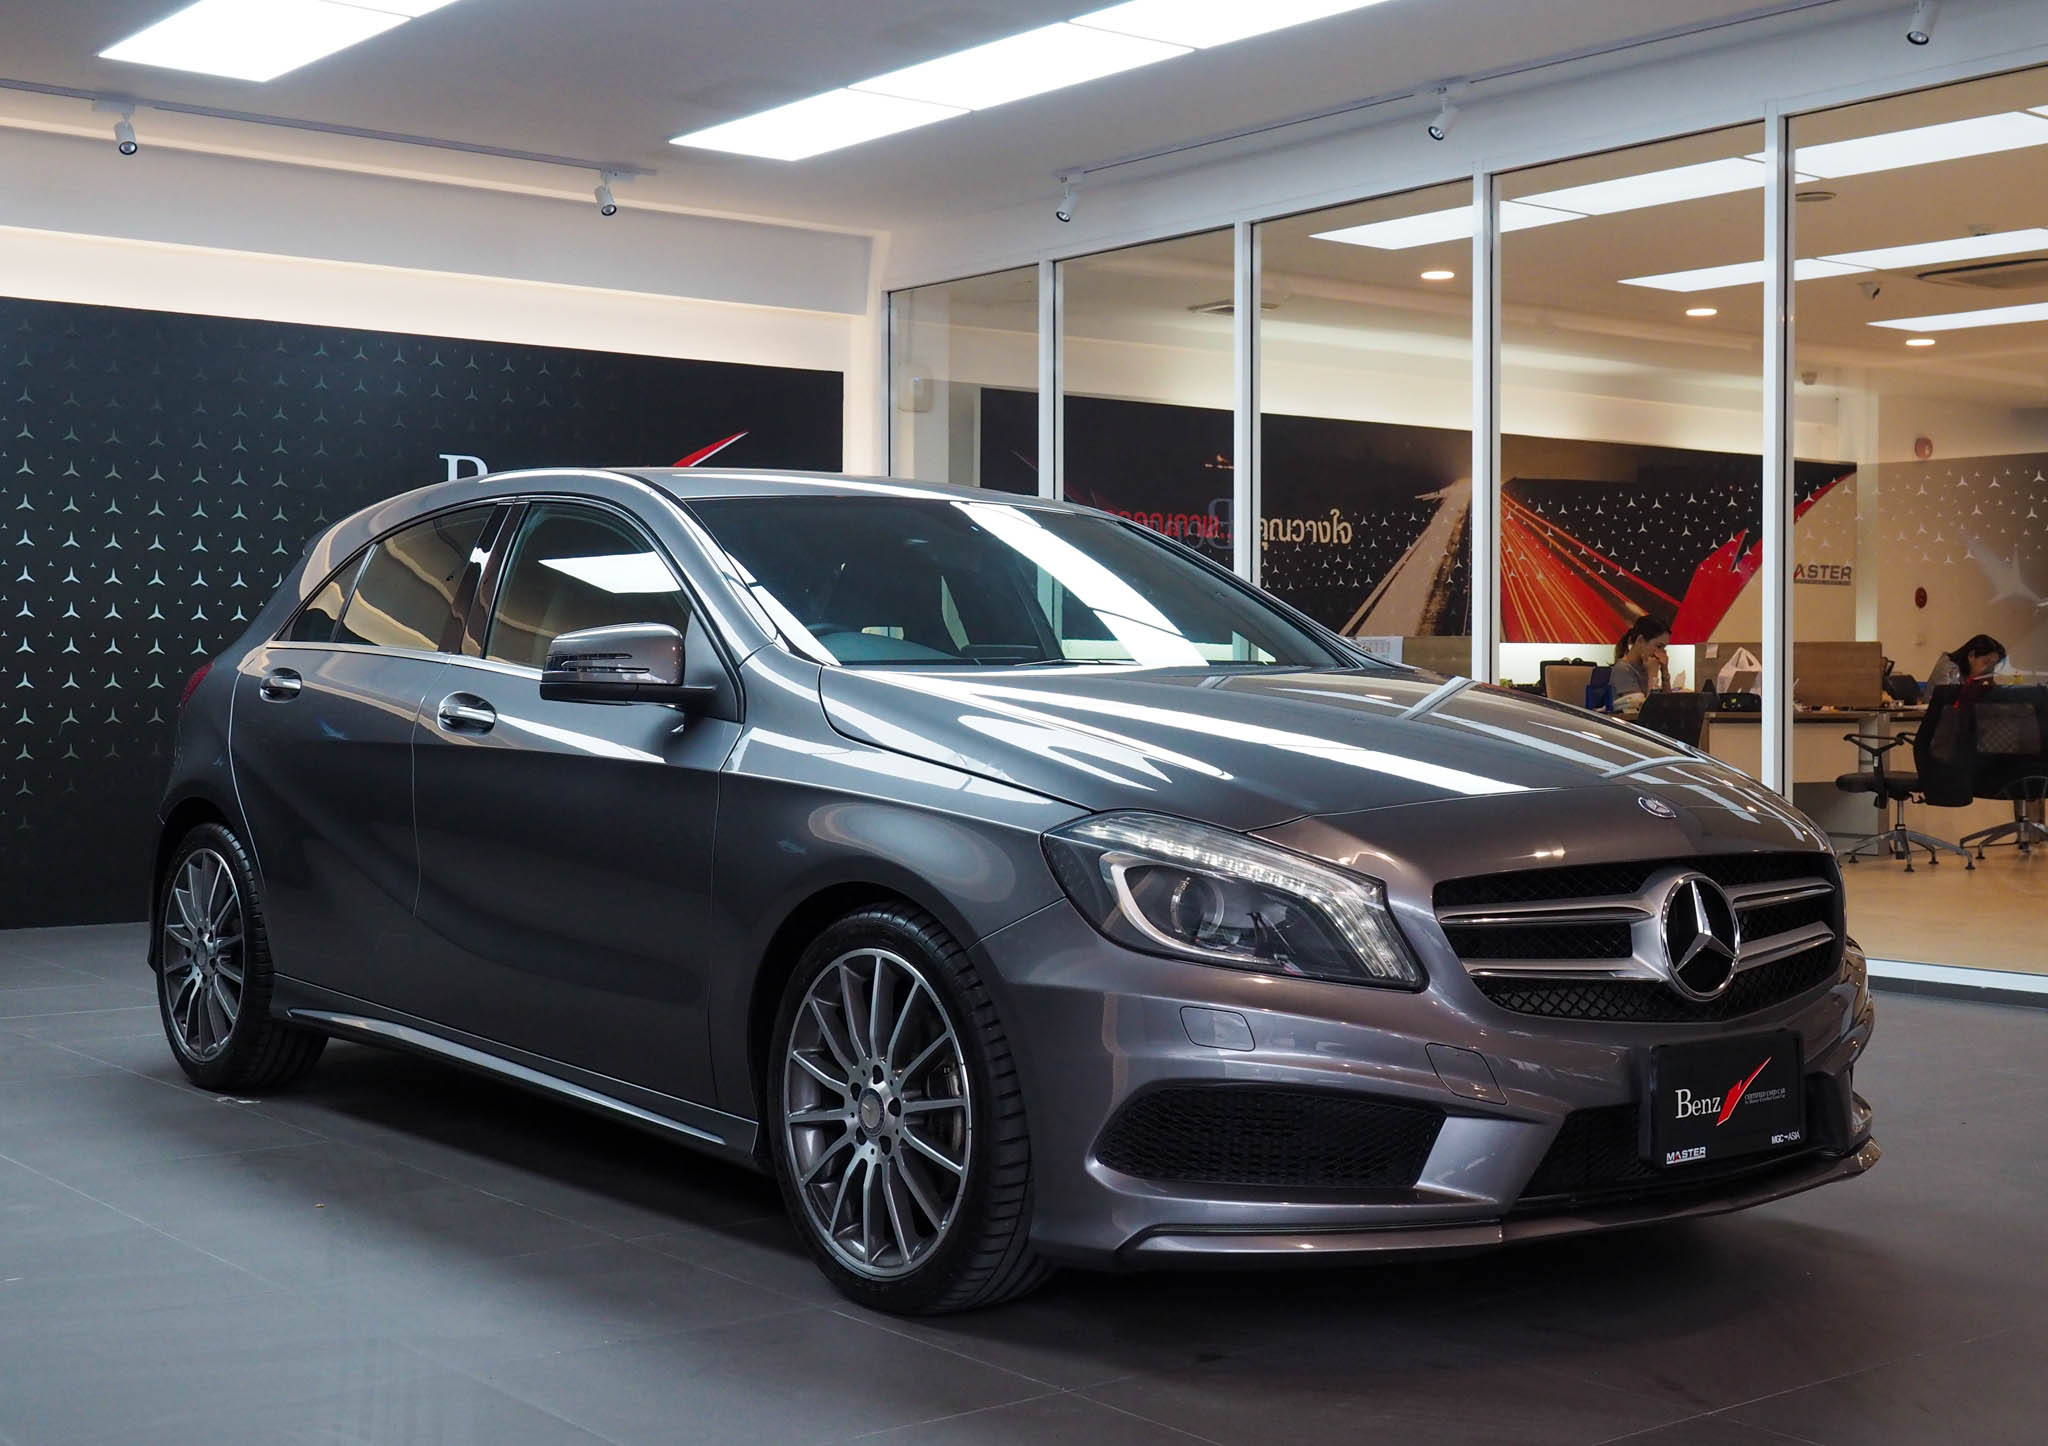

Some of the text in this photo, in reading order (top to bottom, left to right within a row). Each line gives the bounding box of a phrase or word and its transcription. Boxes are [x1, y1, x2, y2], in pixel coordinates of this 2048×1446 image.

[1793, 563, 1852, 580] ASTER
[1674, 1087, 1722, 1119] Benz
[1666, 1146, 1707, 1162] MASTER
